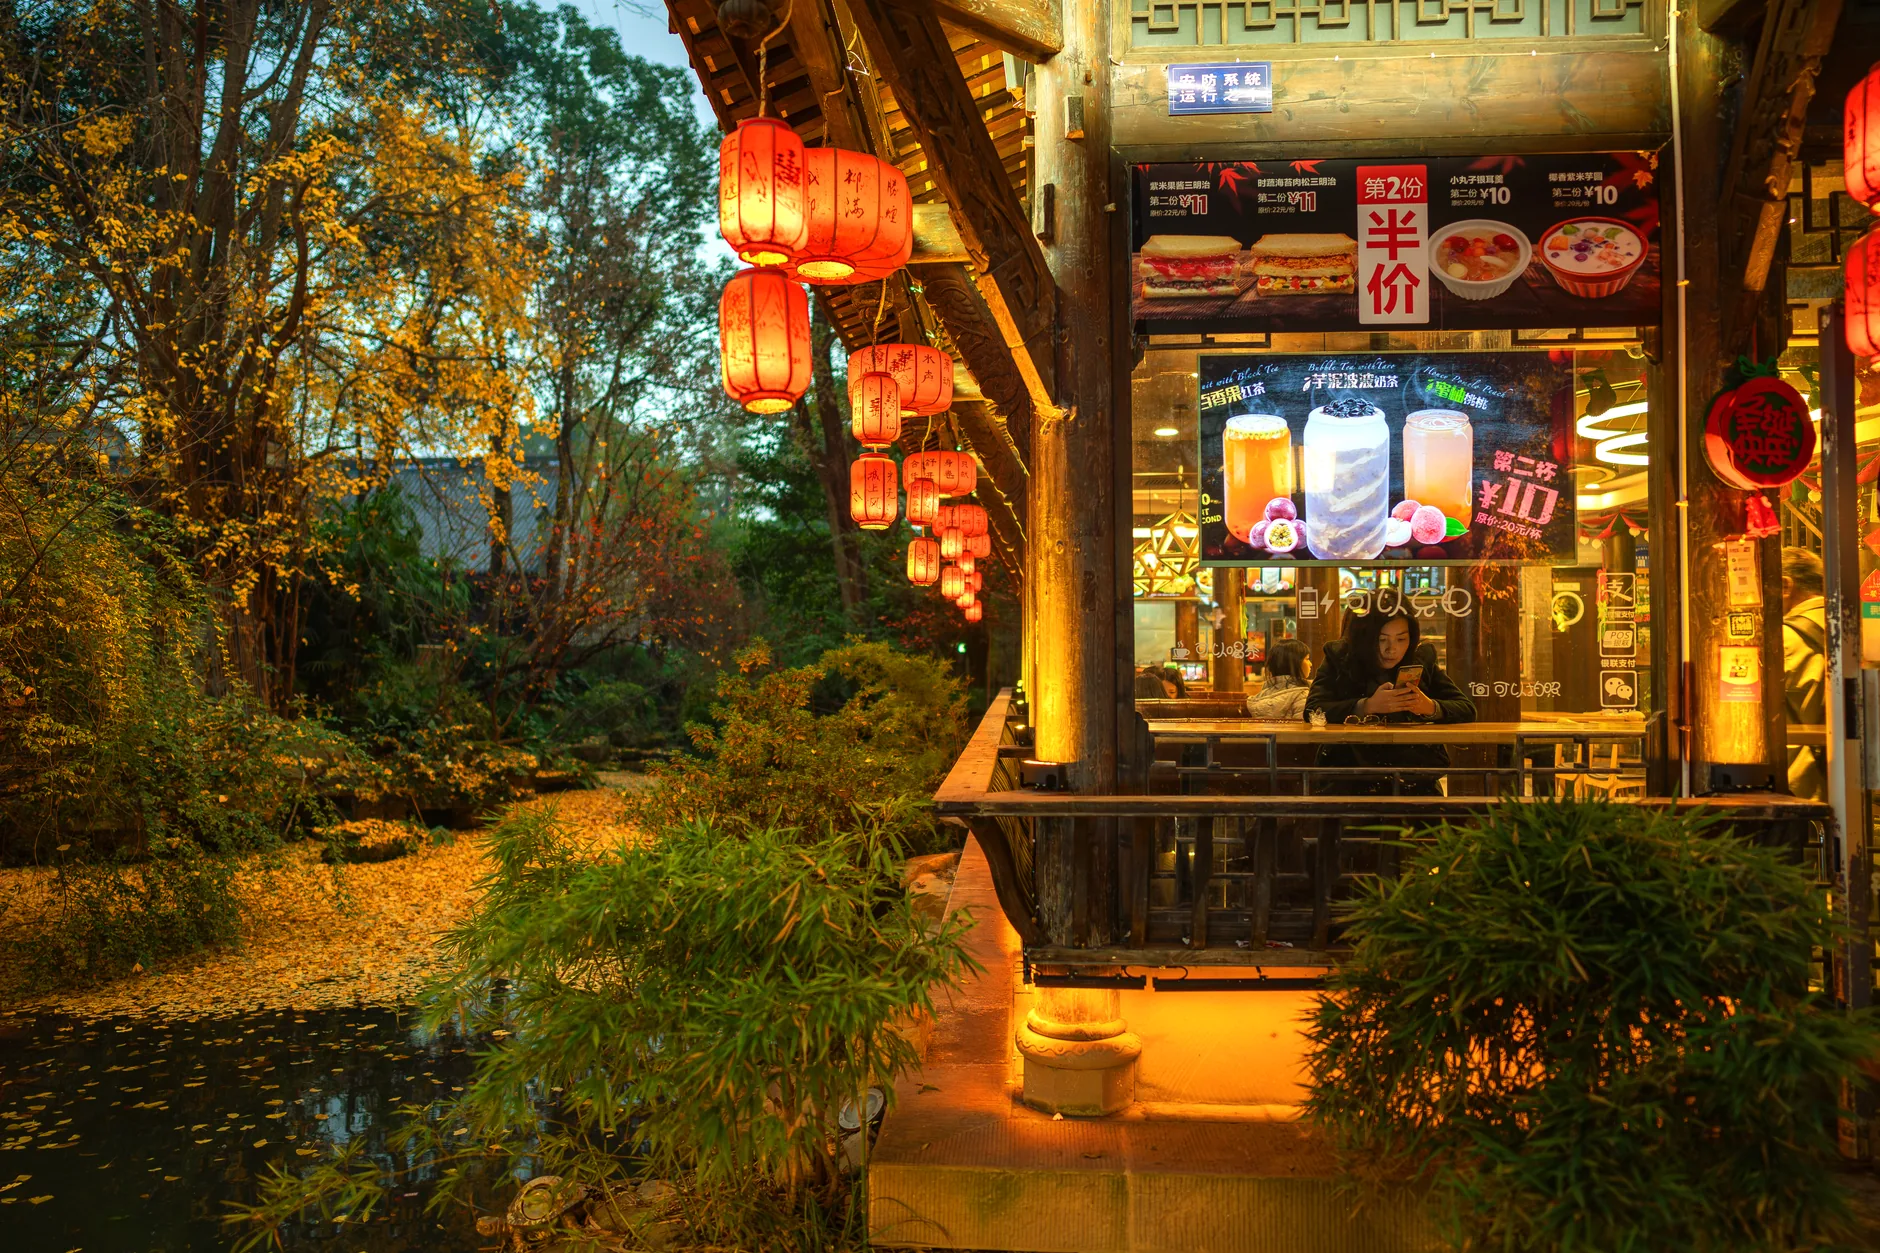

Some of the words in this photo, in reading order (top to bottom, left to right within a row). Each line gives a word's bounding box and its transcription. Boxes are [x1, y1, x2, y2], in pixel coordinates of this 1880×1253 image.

[1180, 72, 1261, 87] 安防系统
[1149, 180, 1210, 191] 紫米果酱三明治
[1257, 177, 1337, 188] 时蔬海苔肉松三明治
[1364, 176, 1423, 199] 第2份
[1150, 196, 1178, 206] 第二份
[1179, 194, 1208, 215] ¥11
[1257, 193, 1287, 203] 第二份
[1287, 191, 1317, 212] ¥11
[1450, 188, 1478, 199] 第二份
[1480, 186, 1511, 205] ¥10
[1551, 187, 1582, 198] 第二份
[1583, 185, 1619, 205] ¥10
[1366, 209, 1420, 315] 半价
[1340, 361, 1355, 371] Tea
[1493, 450, 1559, 482] 第二杯
[1478, 477, 1559, 525] ¥10
[1475, 512, 1543, 540] 原价:20元/杯
[1345, 585, 1472, 618] 可以充电
[1611, 631, 1630, 640] POS
[1600, 659, 1636, 668] 银联支付
